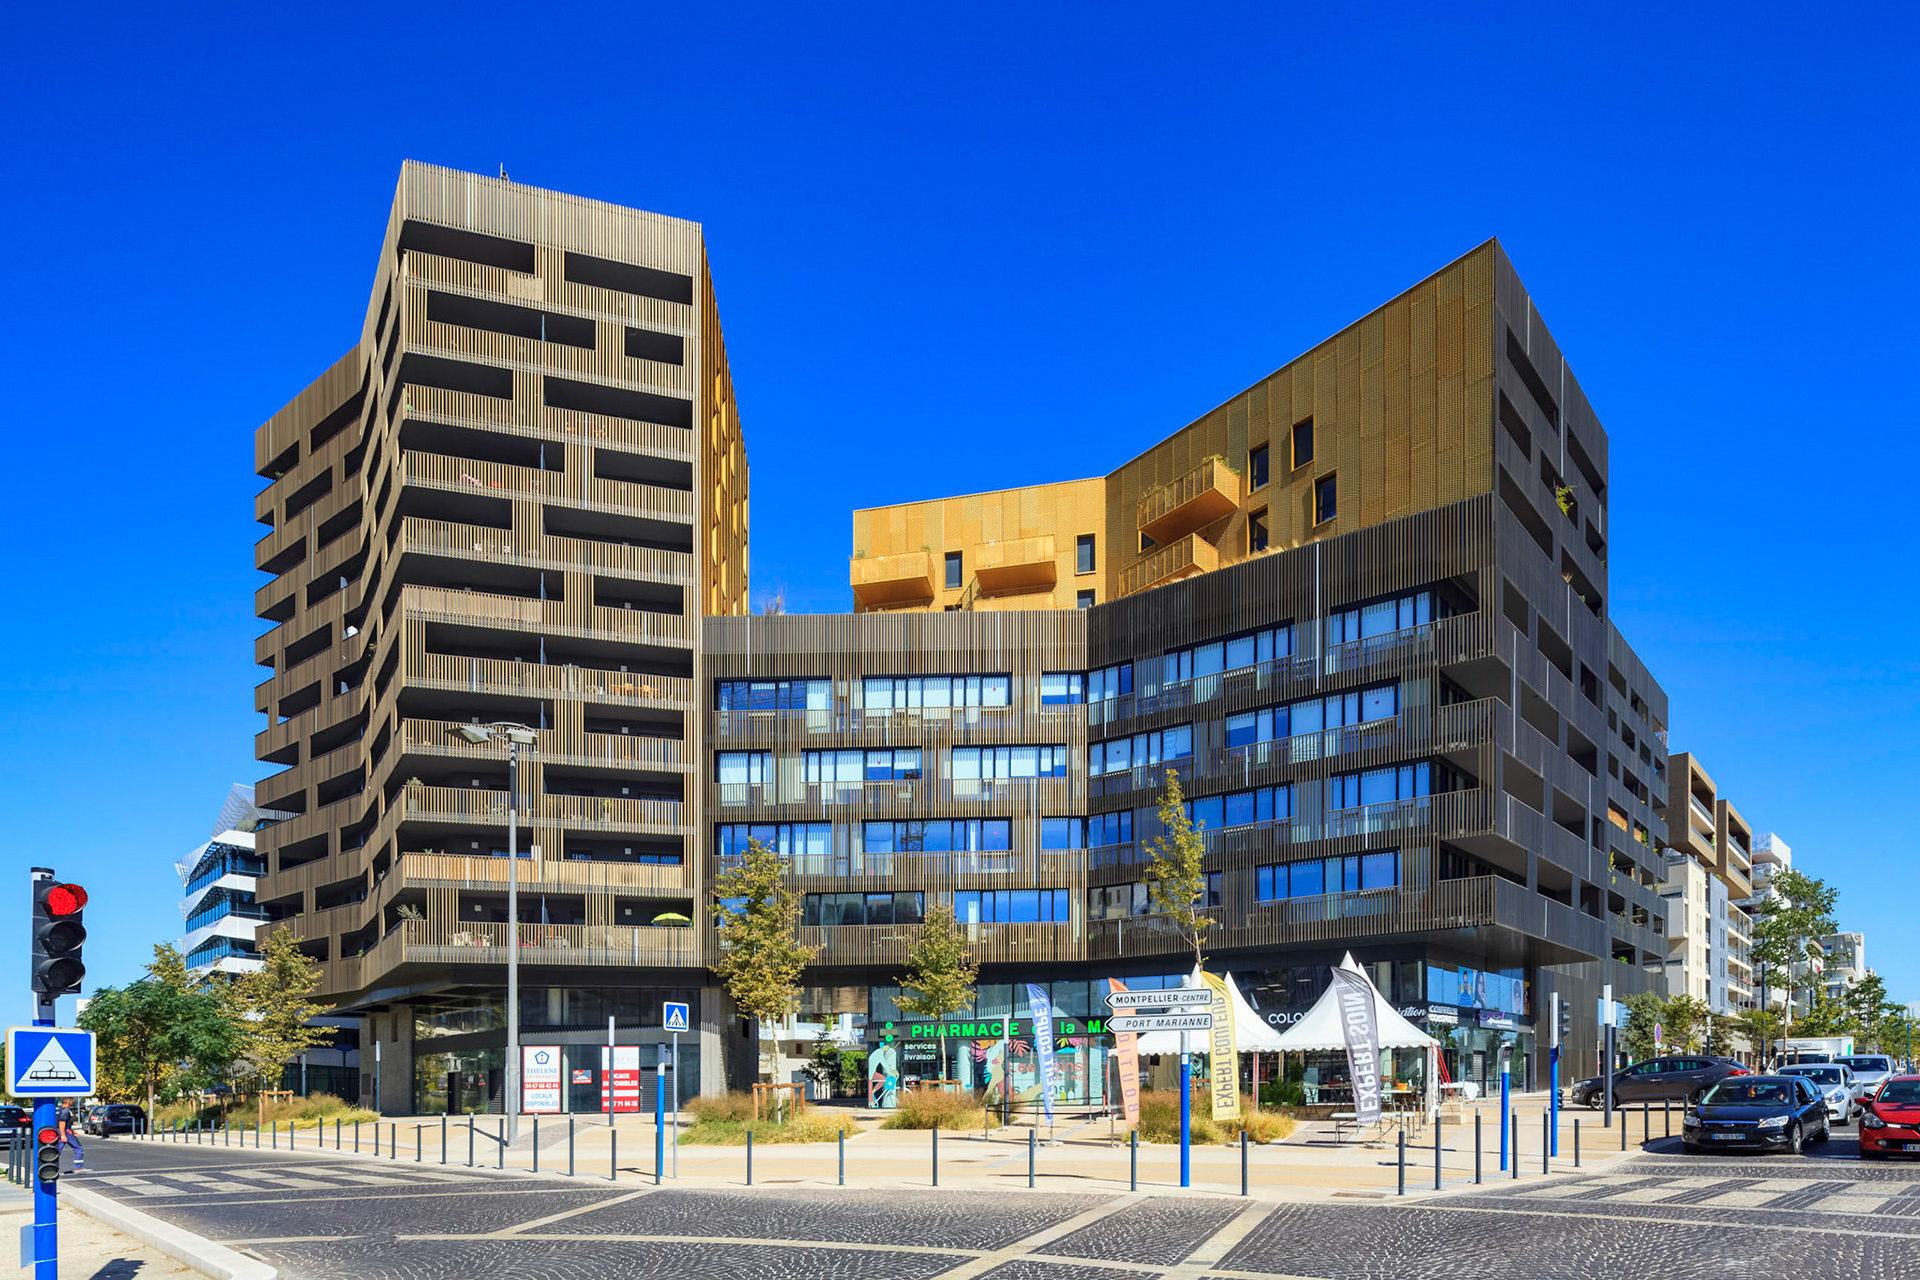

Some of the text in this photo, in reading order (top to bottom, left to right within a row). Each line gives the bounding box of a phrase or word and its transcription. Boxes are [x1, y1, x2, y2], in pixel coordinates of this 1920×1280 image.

[1126, 1017, 1208, 1028] PORT MARIANNE
[1268, 1012, 1306, 1024] COLO
[911, 1022, 1019, 1038] PHARMACE
[1060, 1021, 1075, 1034] la
[904, 1053, 936, 1061] livraison
[1052, 1059, 1083, 1073] oins
